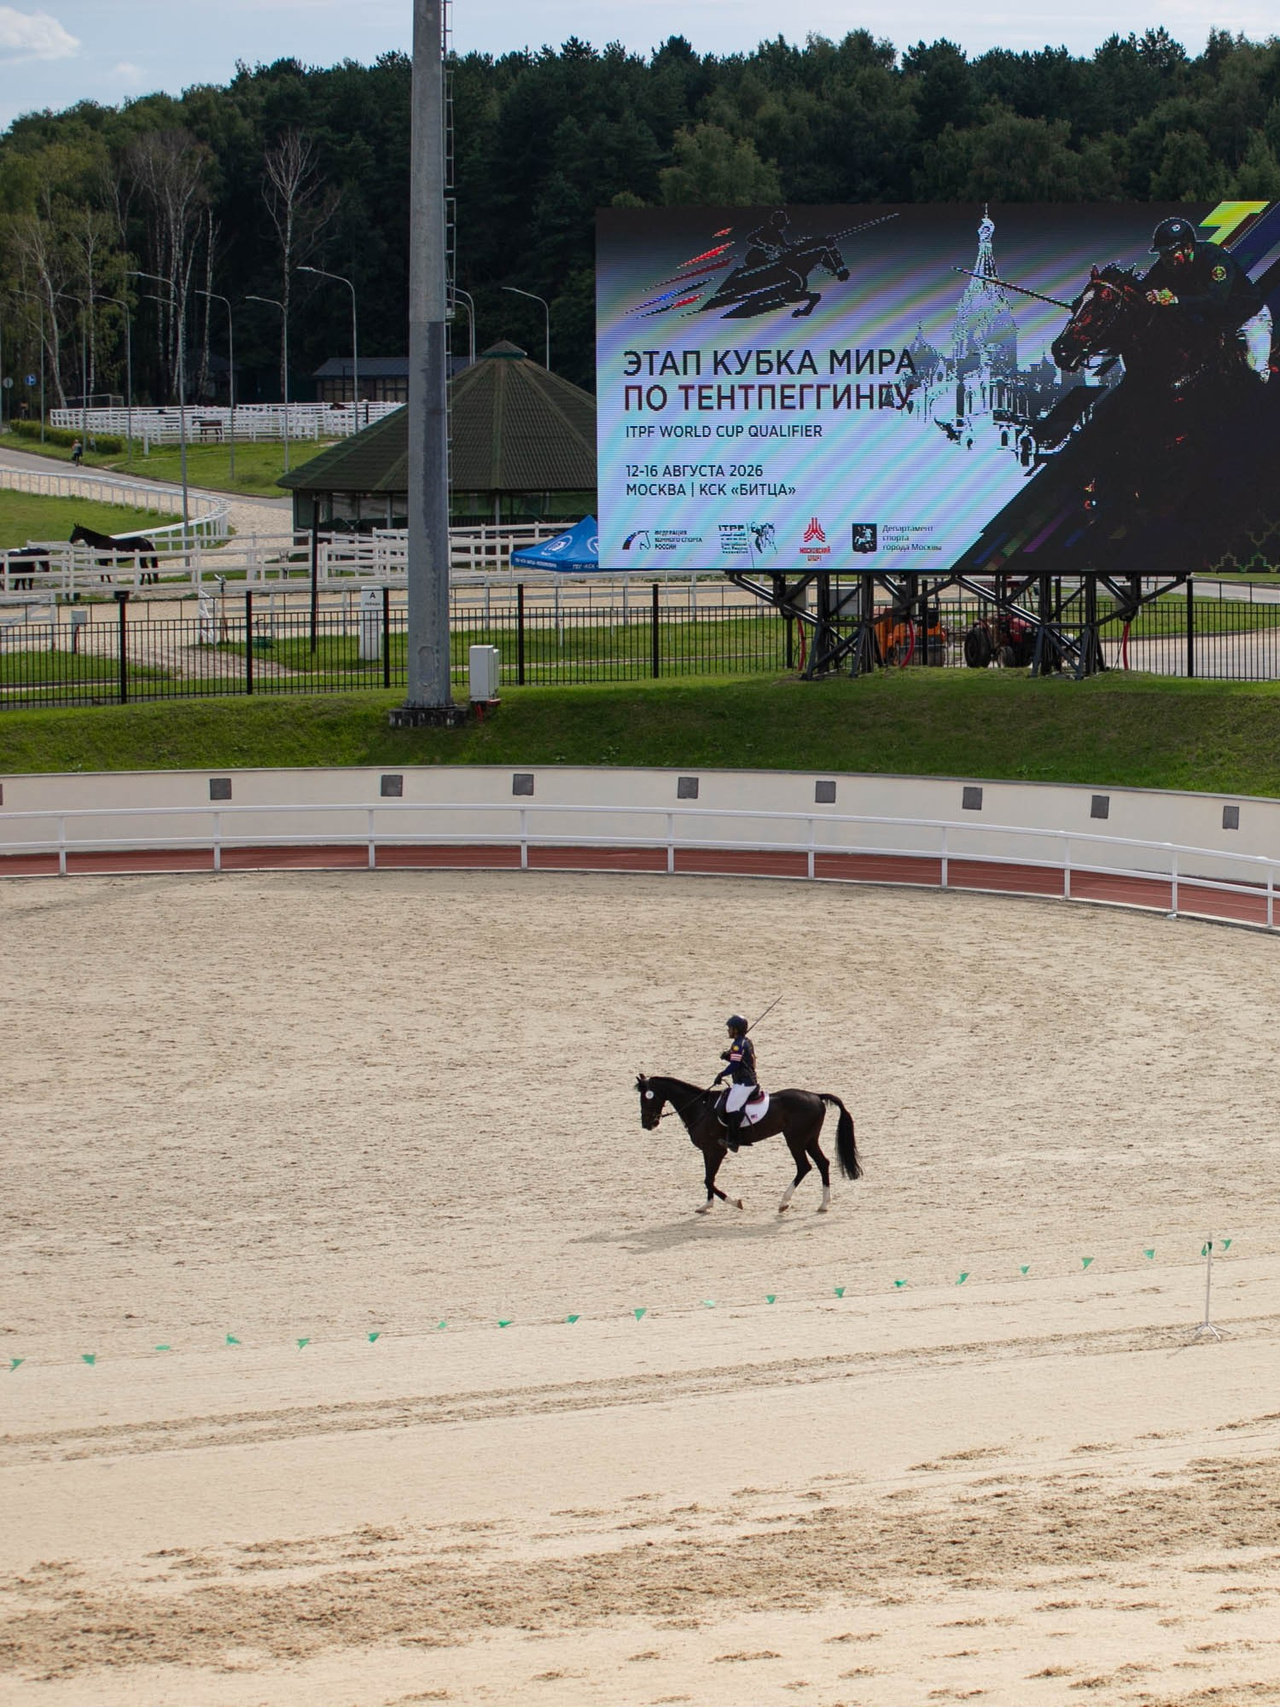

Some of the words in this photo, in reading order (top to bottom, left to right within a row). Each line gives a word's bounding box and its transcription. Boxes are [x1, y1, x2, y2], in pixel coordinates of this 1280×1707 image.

[623, 350, 701, 376] ЭТАП
[713, 349, 818, 376] КУБКА
[829, 349, 916, 375] МИРА
[624, 384, 668, 411] ПО
[678, 384, 912, 411] ТЕНТПЕГГИНГУ
[626, 425, 655, 438] ITPF
[659, 425, 712, 438] WORLD
[716, 425, 744, 438] CUP
[749, 425, 823, 438] QUALIFIER
[626, 464, 658, 477] 12-16
[662, 464, 725, 477] АВГУСТА
[730, 464, 763, 477] 2026
[626, 483, 686, 496] МОСКВА
[700, 483, 727, 496] КСК
[731, 483, 796, 497] «БИТЦА»
